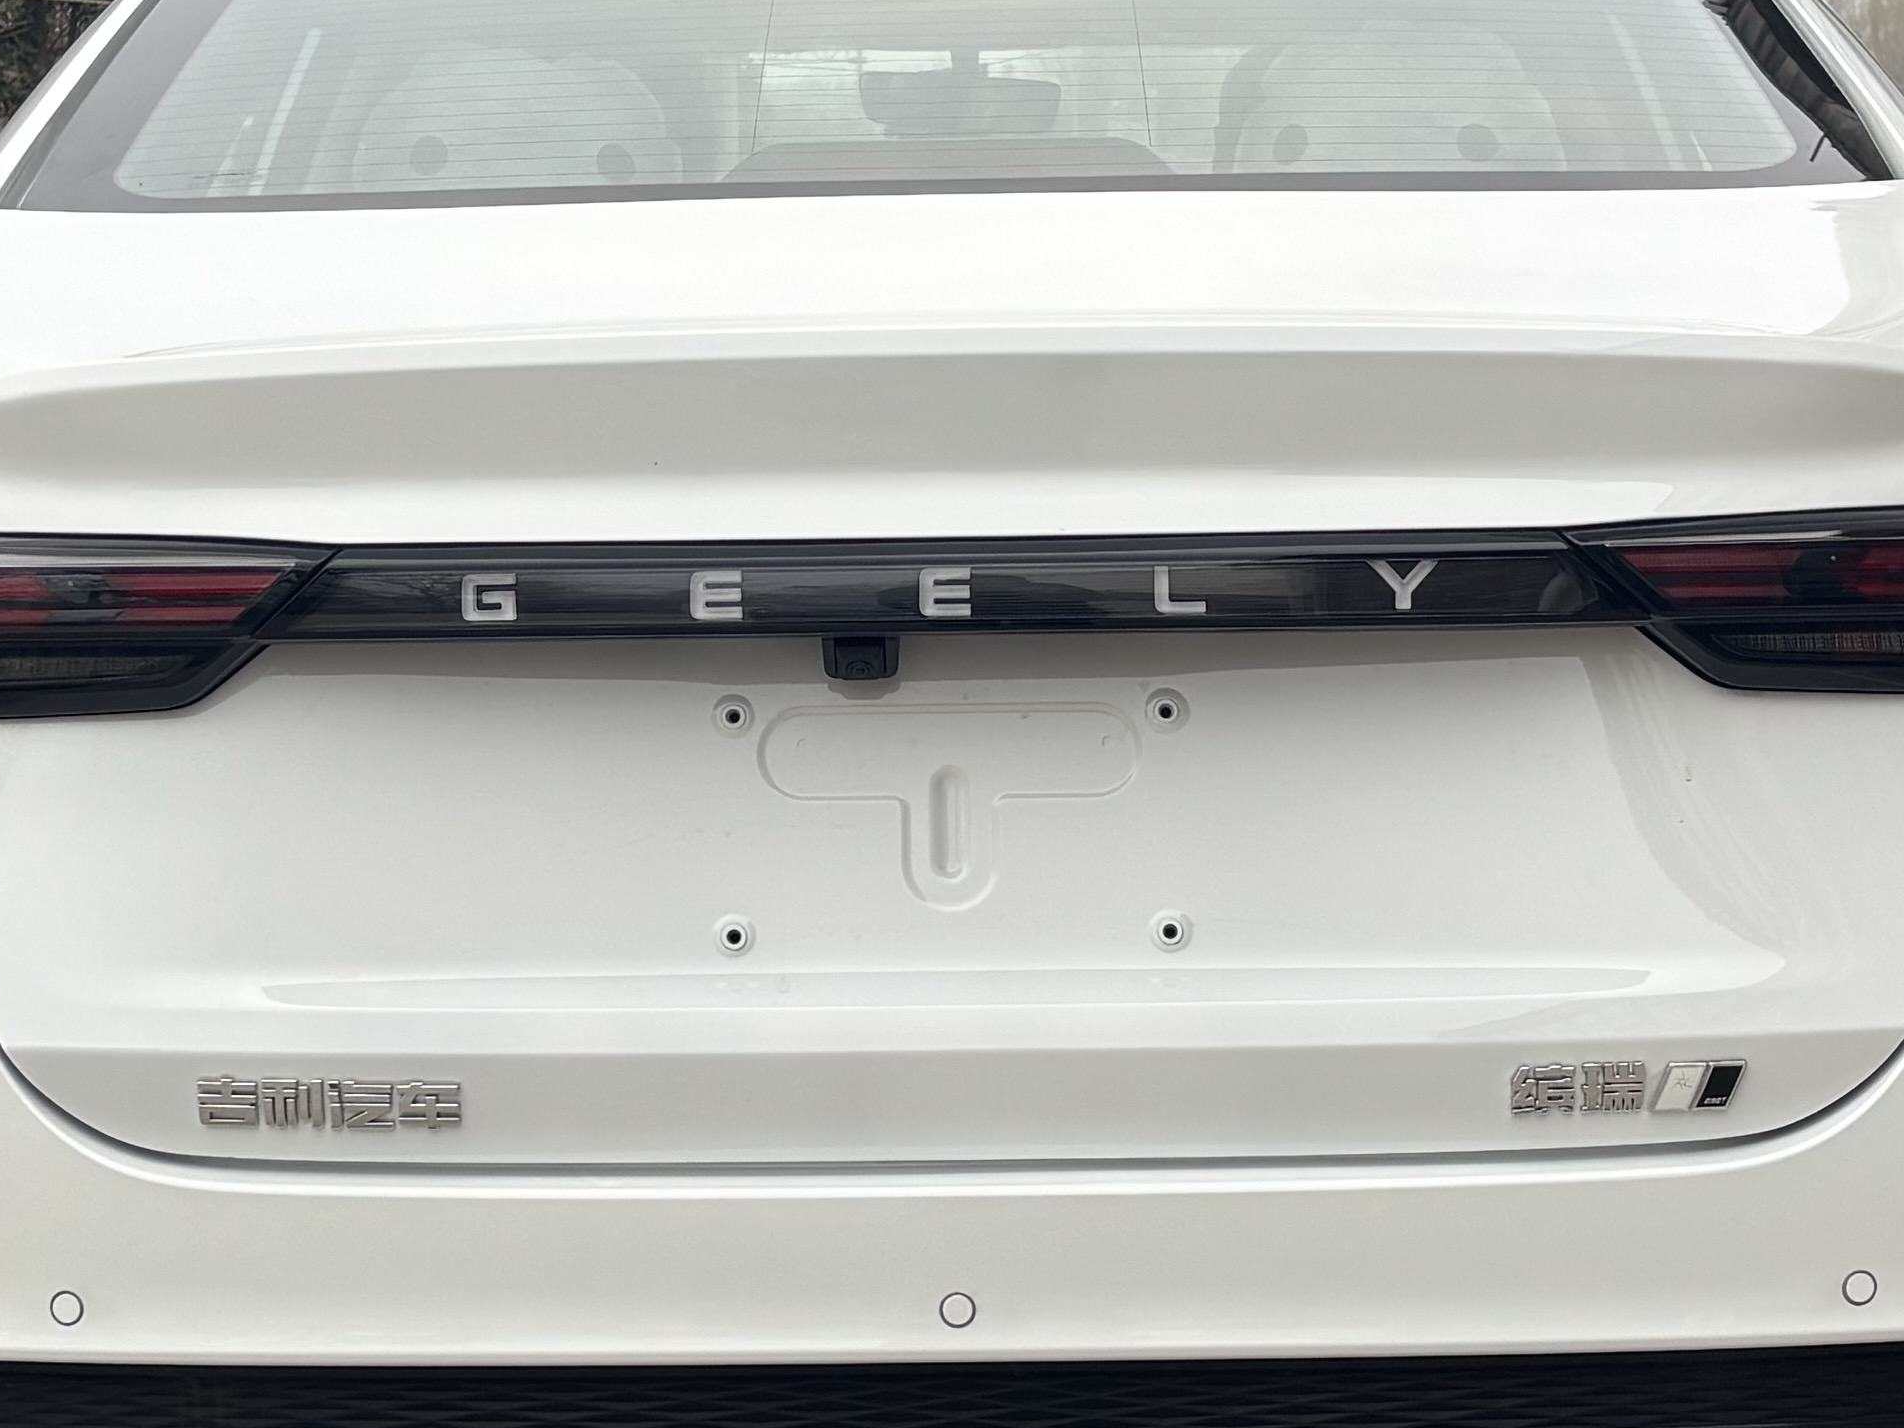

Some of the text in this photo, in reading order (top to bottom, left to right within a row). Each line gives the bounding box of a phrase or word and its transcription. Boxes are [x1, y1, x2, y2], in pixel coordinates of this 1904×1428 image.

[460, 558, 1439, 623] GEELY
[196, 1075, 462, 1130] 吉利汽车
[1510, 1061, 1646, 1115] 缤瑞
